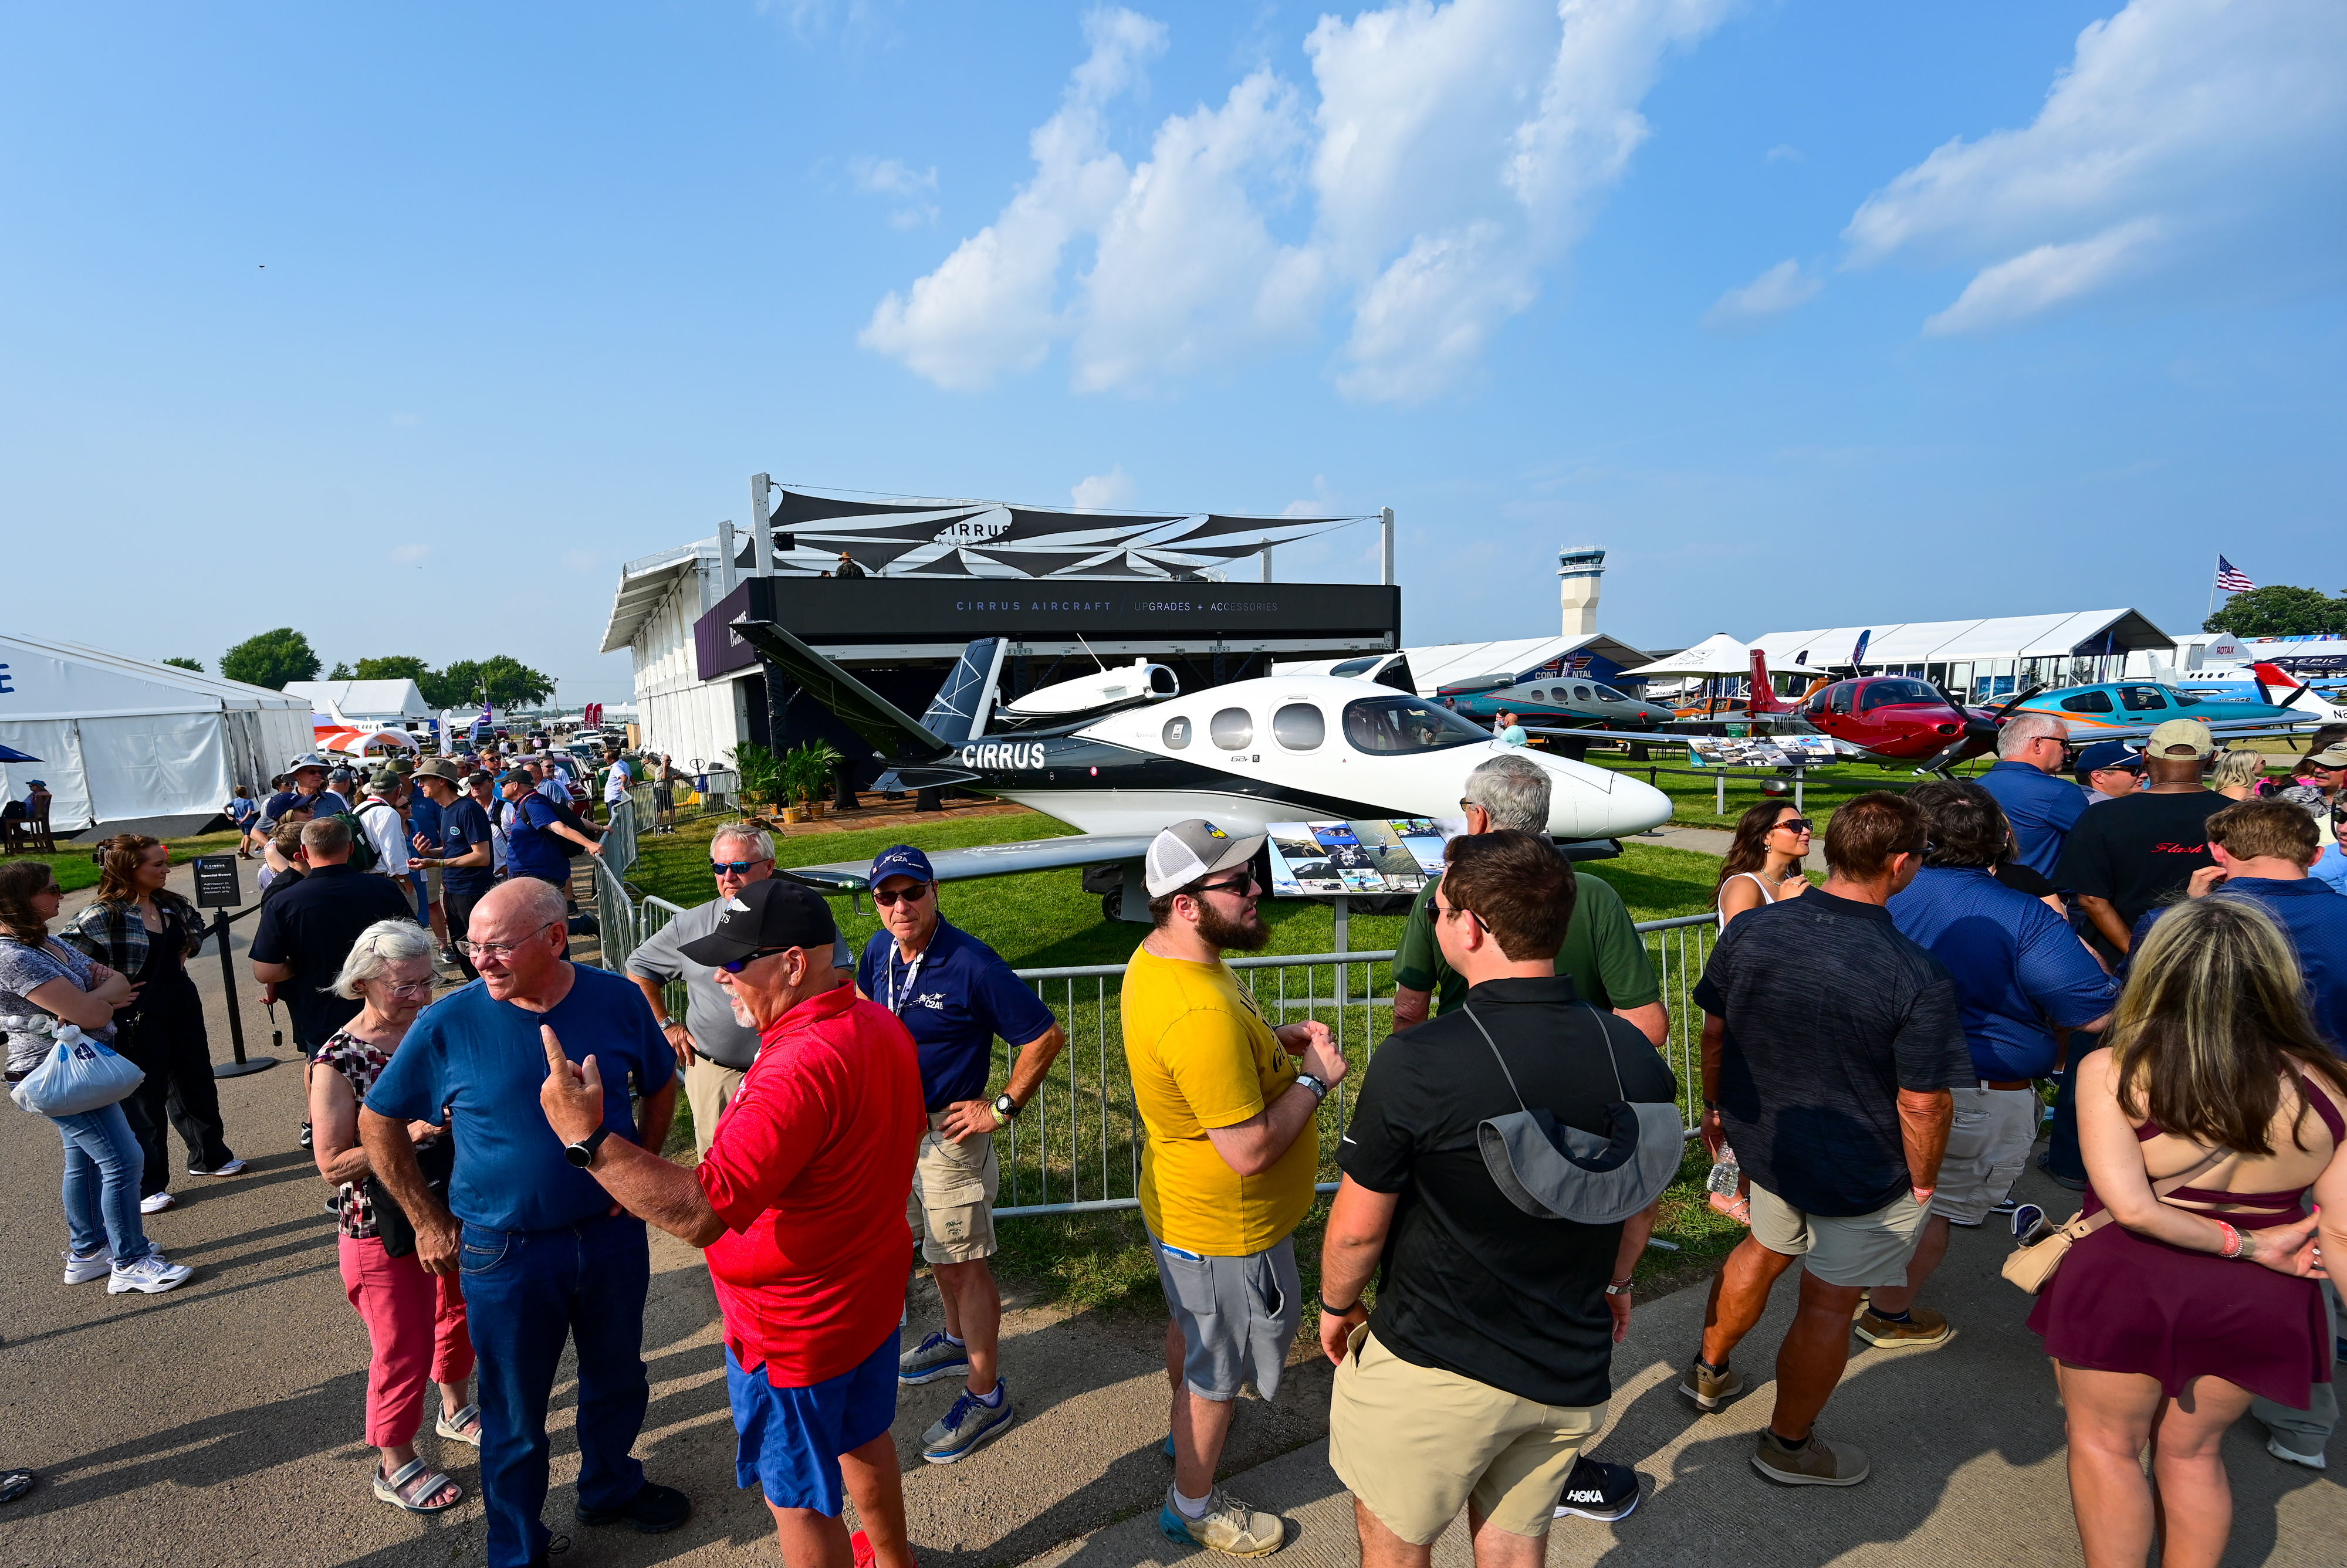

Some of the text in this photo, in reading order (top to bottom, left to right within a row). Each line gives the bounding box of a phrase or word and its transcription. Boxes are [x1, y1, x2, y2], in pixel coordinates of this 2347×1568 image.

[956, 601, 1111, 610] CIRRUS AIRCRAFT
[1134, 602, 1191, 611] UPGRADES
[1210, 602, 1278, 611] ACCESSORIES
[2216, 645, 2235, 655] ROTAX
[1535, 670, 1592, 680] CONTNTAL
[962, 743, 1045, 770] CIRRUS
[2150, 842, 2204, 854] Flash
[721, 913, 731, 924] YS
[925, 1000, 940, 1010] C2A
[1567, 1489, 1604, 1503] HOKA
